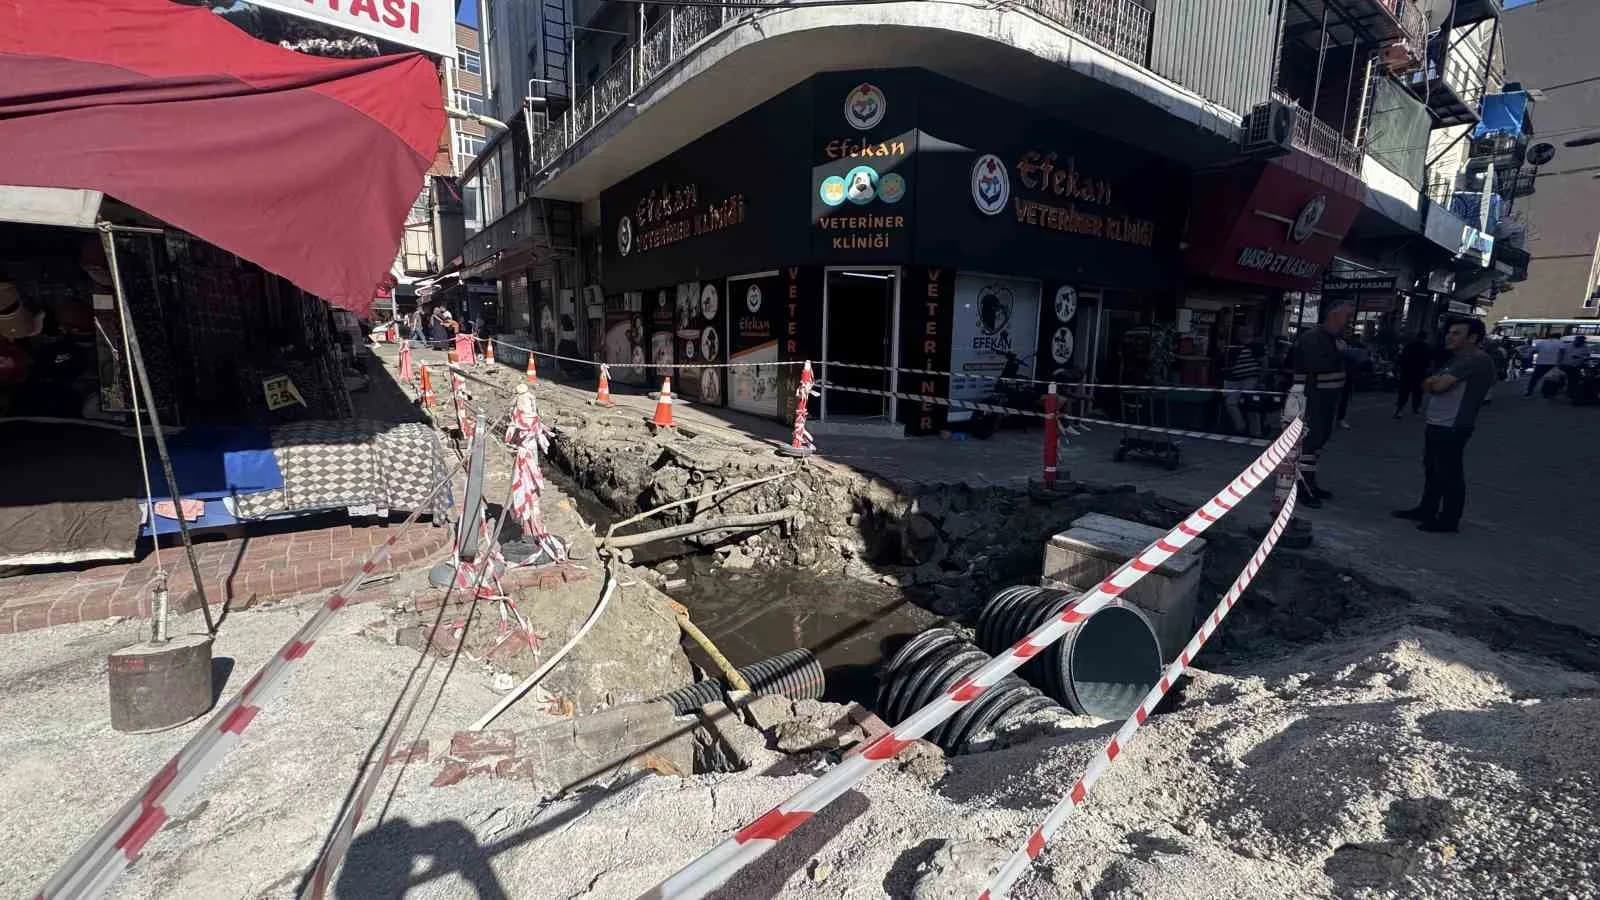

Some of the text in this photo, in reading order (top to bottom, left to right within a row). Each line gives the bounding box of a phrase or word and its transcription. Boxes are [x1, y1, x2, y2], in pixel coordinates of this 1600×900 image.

[826, 137, 905, 158] Efekan
[1016, 151, 1112, 206] Efekan
[820, 212, 904, 230] VETERİNER
[1016, 197, 1104, 237] VETERİNER
[832, 232, 889, 249] KLİNİĞİ
[1236, 248, 1274, 271] NASİP
[1269, 255, 1288, 273] ET
[973, 335, 1012, 351] EFEKAN
